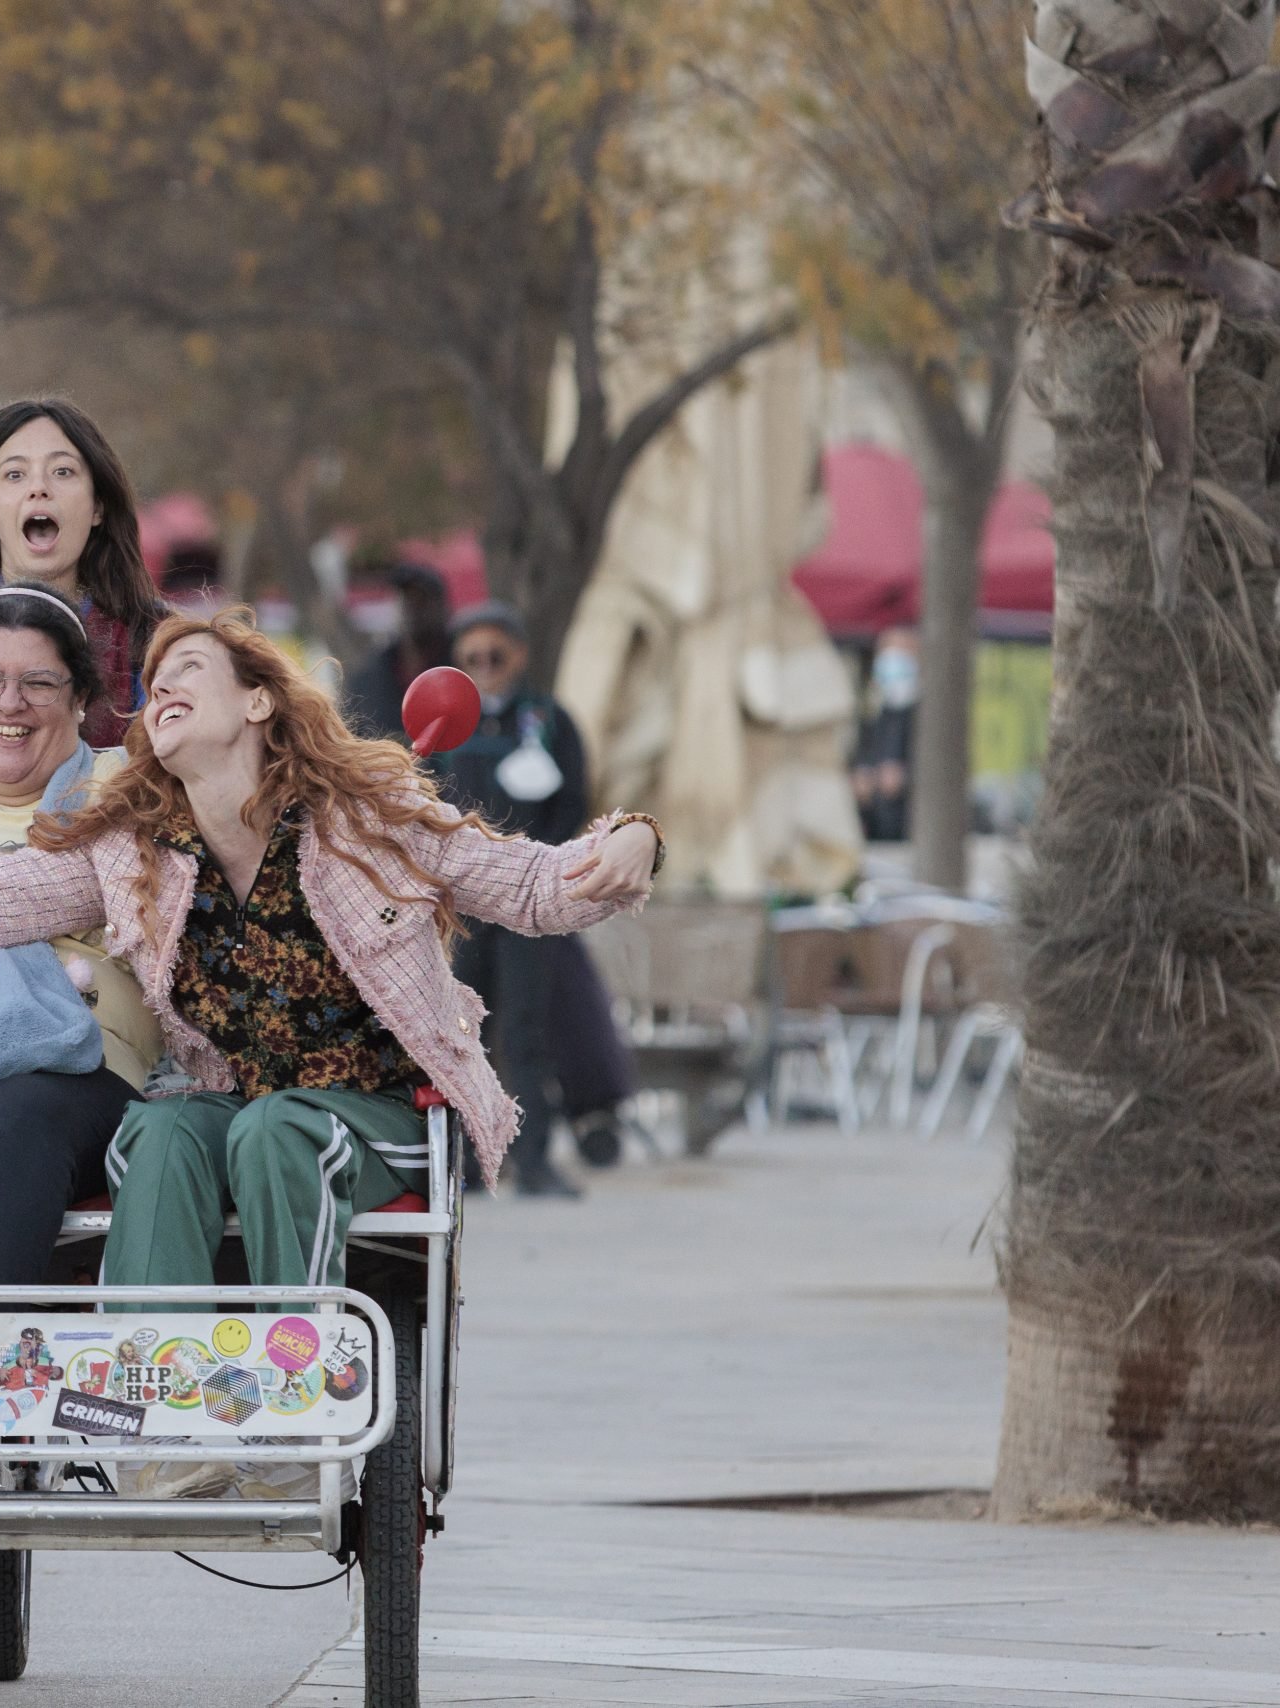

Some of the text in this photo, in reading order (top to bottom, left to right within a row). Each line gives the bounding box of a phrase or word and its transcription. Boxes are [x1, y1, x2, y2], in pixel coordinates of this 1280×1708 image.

[331, 1350, 348, 1364] HIP
[324, 1358, 345, 1374] HOP
[127, 1367, 172, 1383] HIP
[60, 1401, 140, 1433] CRIMEN
